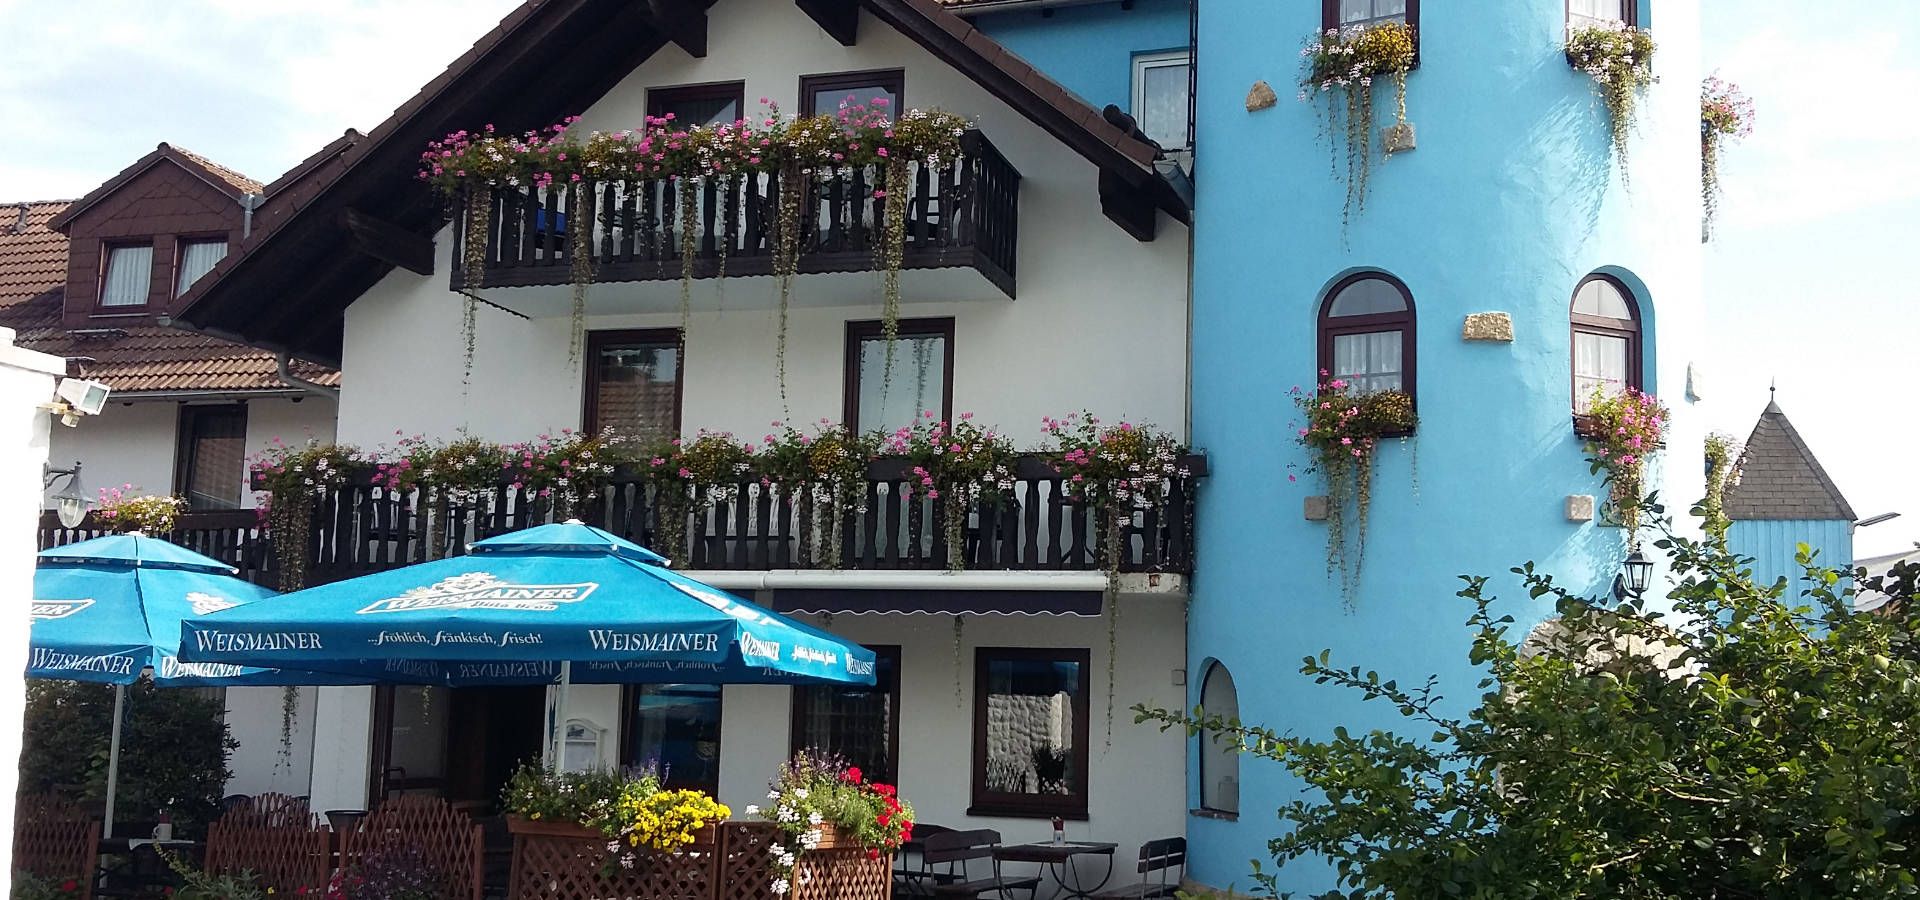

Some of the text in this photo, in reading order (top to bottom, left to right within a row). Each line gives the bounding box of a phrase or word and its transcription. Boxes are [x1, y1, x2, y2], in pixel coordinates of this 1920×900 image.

[386, 588, 577, 609] WEISMAINER
[194, 629, 322, 652] WEISMAINER
[431, 630, 497, 646] fränkisch,
[498, 631, 543, 647] frisch!
[588, 629, 718, 652] WEISMAINER
[32, 647, 134, 675] WEISMAINER
